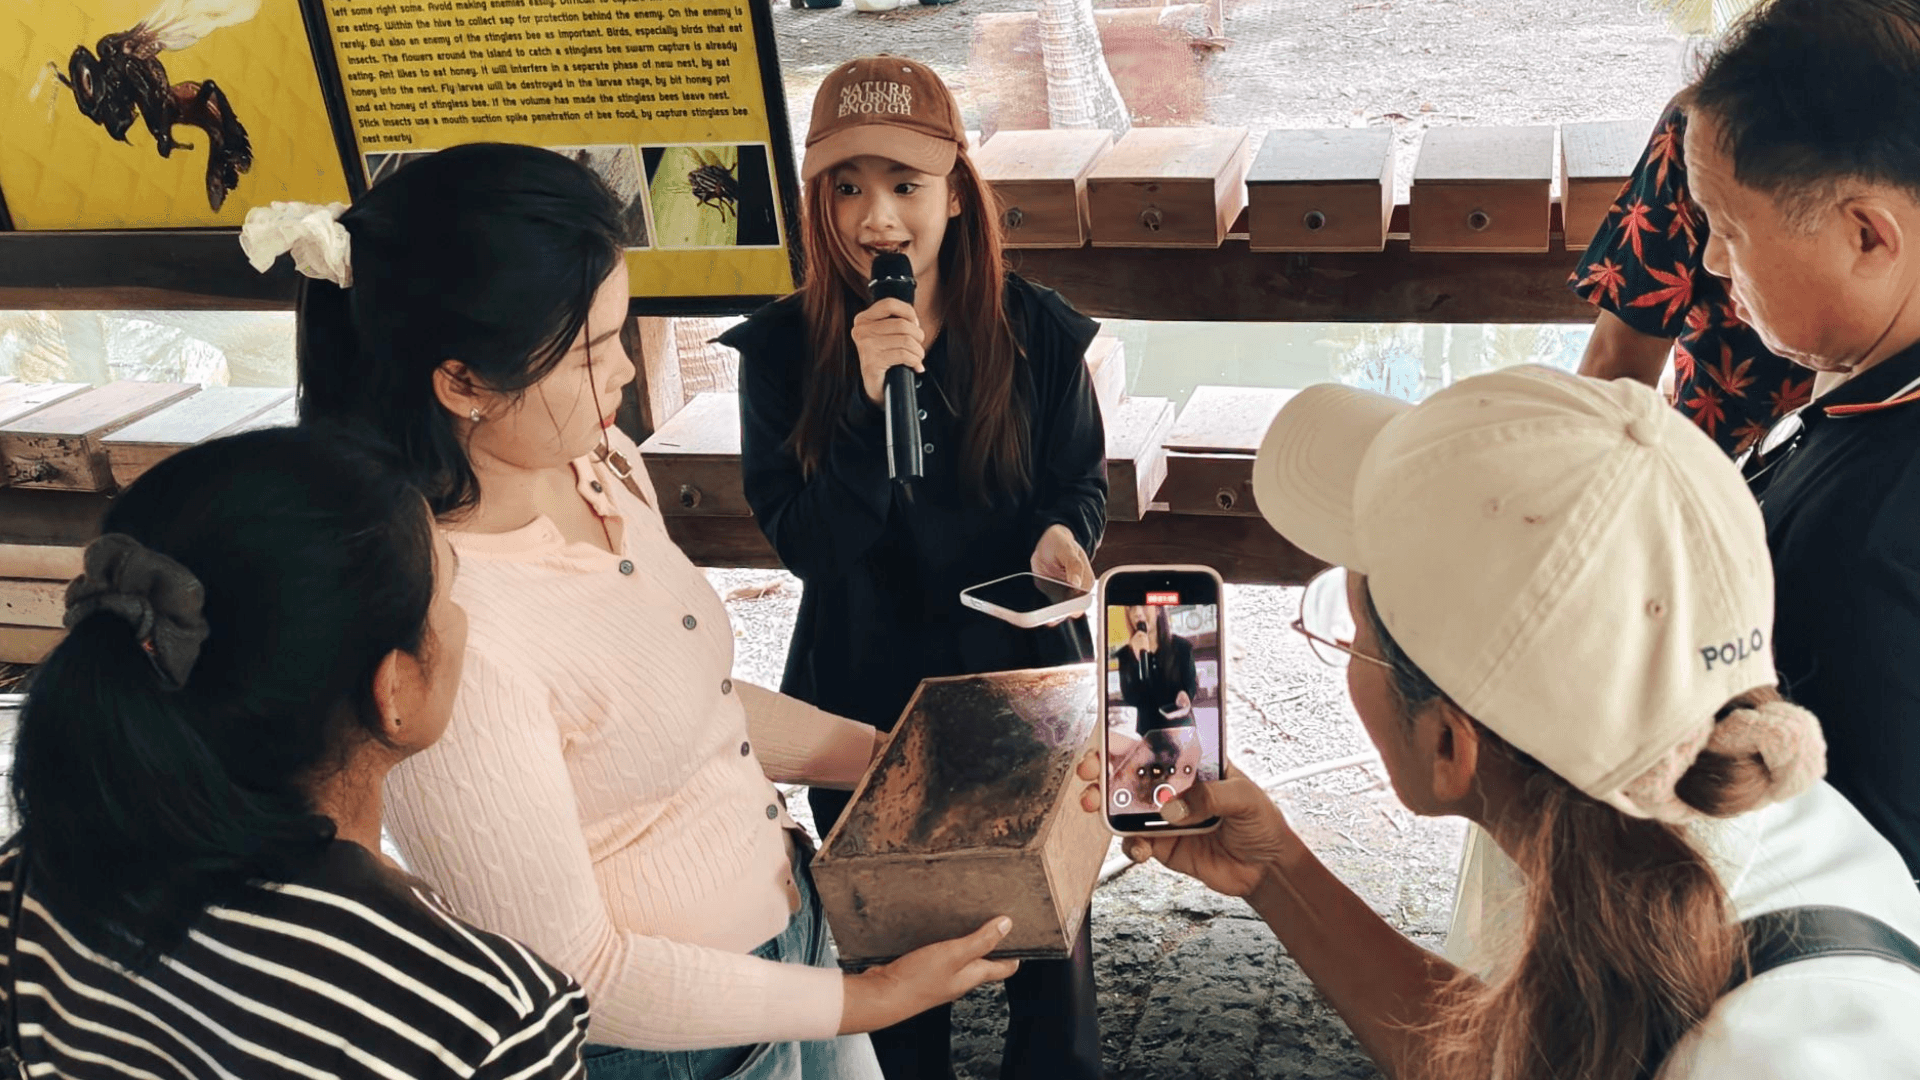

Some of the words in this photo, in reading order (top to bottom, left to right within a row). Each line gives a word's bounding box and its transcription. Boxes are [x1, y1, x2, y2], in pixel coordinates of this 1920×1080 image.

[351, 7, 373, 15] some
[376, 4, 397, 16] right
[428, 0, 452, 11] Avoid
[455, 0, 487, 11] making
[490, 0, 525, 8] enemies
[337, 25, 350, 33] are
[384, 20, 413, 30] Within
[416, 20, 430, 29] the
[433, 19, 452, 27] hive
[455, 17, 465, 26] to
[468, 16, 496, 26] collect
[499, 17, 514, 26] sap
[518, 14, 530, 23] for
[534, 12, 579, 25] protection
[582, 10, 612, 21] behind
[615, 10, 630, 19] the
[668, 8, 681, 17] On
[684, 7, 699, 17] the
[703, 8, 731, 18] enemy
[734, 6, 743, 15] is
[370, 38, 385, 47] But
[389, 37, 406, 46] also
[423, 36, 451, 46] enemy
[454, 34, 463, 43] of
[467, 33, 481, 42] the
[485, 32, 522, 43] stingless
[526, 30, 541, 39] bee
[635, 25, 678, 38] especially
[681, 24, 703, 34] birds
[707, 23, 725, 33] that
[729, 23, 742, 32] eat
[383, 54, 398, 63] The
[401, 53, 433, 62] flowers
[437, 50, 466, 60] around
[469, 50, 483, 58] the
[487, 48, 512, 58] island
[516, 48, 525, 57] to
[529, 47, 552, 56] catch
[564, 45, 603, 57] stingless
[606, 44, 622, 53] bee
[625, 44, 654, 53] swarm
[658, 42, 690, 54] capture
[694, 41, 702, 51] is
[705, 40, 737, 52] already
[379, 70, 394, 79] Ant
[398, 69, 417, 78] likes
[420, 68, 429, 77] to
[433, 67, 446, 77] eat
[481, 65, 488, 74] It
[492, 65, 508, 74] will
[510, 63, 547, 73] interfere
[551, 63, 559, 72] in
[573, 61, 609, 73] separate
[613, 60, 638, 72] phase
[642, 59, 651, 68] of
[702, 58, 712, 69] by
[716, 57, 730, 66] eat
[352, 88, 377, 98] honey
[380, 86, 396, 95] into
[400, 85, 413, 94] the
[441, 83, 454, 95] Fly
[488, 81, 503, 90] will
[506, 81, 516, 90] be
[521, 79, 562, 91] destroyed
[567, 79, 574, 88] in
[579, 78, 592, 87] the
[656, 76, 666, 87] by
[670, 75, 681, 84] bit
[686, 75, 712, 86] honey
[716, 74, 730, 85] pot
[840, 81, 911, 96] NATURE
[355, 103, 371, 112] and
[373, 102, 387, 111] eat
[390, 102, 416, 112] honey
[419, 100, 428, 109] of
[431, 99, 469, 111] stingless
[492, 98, 499, 106] If
[502, 97, 517, 106] the
[520, 96, 551, 105] volume
[554, 96, 569, 104] has
[573, 94, 596, 104] made
[599, 94, 614, 103] the
[617, 93, 656, 104] stingless
[659, 92, 679, 101] bees
[682, 91, 705, 100] leave
[838, 102, 911, 117] ENOUGH
[843, 92, 912, 106] JOURNEY
[359, 118, 380, 128] Stick
[382, 117, 411, 126] insects
[433, 117, 438, 125] a
[441, 115, 468, 124] mouth
[471, 114, 502, 123] suction
[506, 113, 528, 124] spike
[531, 111, 580, 124] penetration
[584, 110, 593, 119] of
[597, 110, 612, 119] bee
[641, 109, 652, 120] by
[656, 108, 688, 120] capture
[691, 107, 729, 118] stingless
[733, 106, 748, 116] bee
[362, 134, 380, 145] nest
[383, 133, 412, 144] nearby
[1699, 628, 1763, 671] POLO
